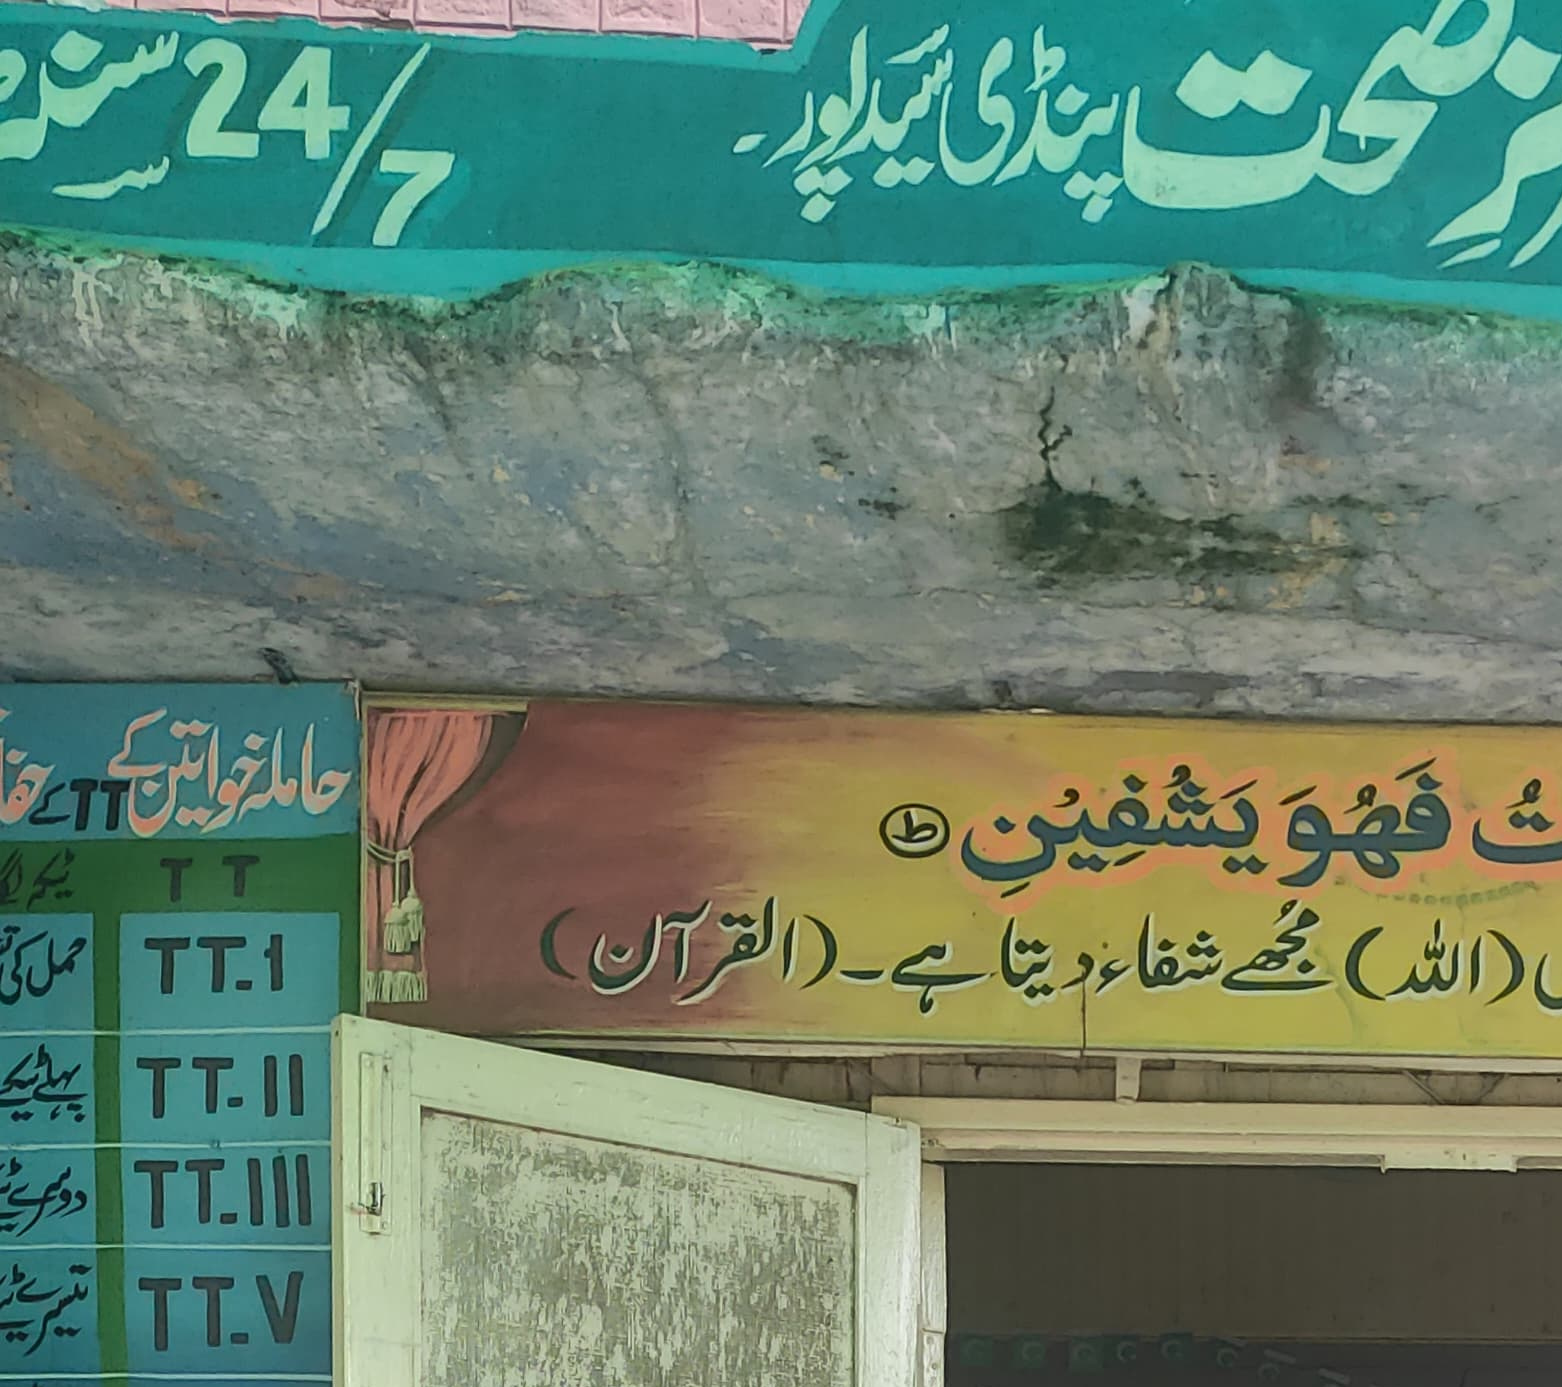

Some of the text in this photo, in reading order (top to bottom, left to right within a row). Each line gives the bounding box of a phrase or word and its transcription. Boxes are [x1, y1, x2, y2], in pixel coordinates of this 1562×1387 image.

[185, 38, 455, 247] 24/7
[938, 24, 1122, 223] پنڈی
[1123, 0, 1515, 209] صحت
[107, 707, 167, 778] کے
[127, 720, 270, 838] خواتین
[237, 722, 352, 826] حاملہ
[999, 915, 1092, 1008] دیتا
[1094, 912, 1226, 996] شفاء
